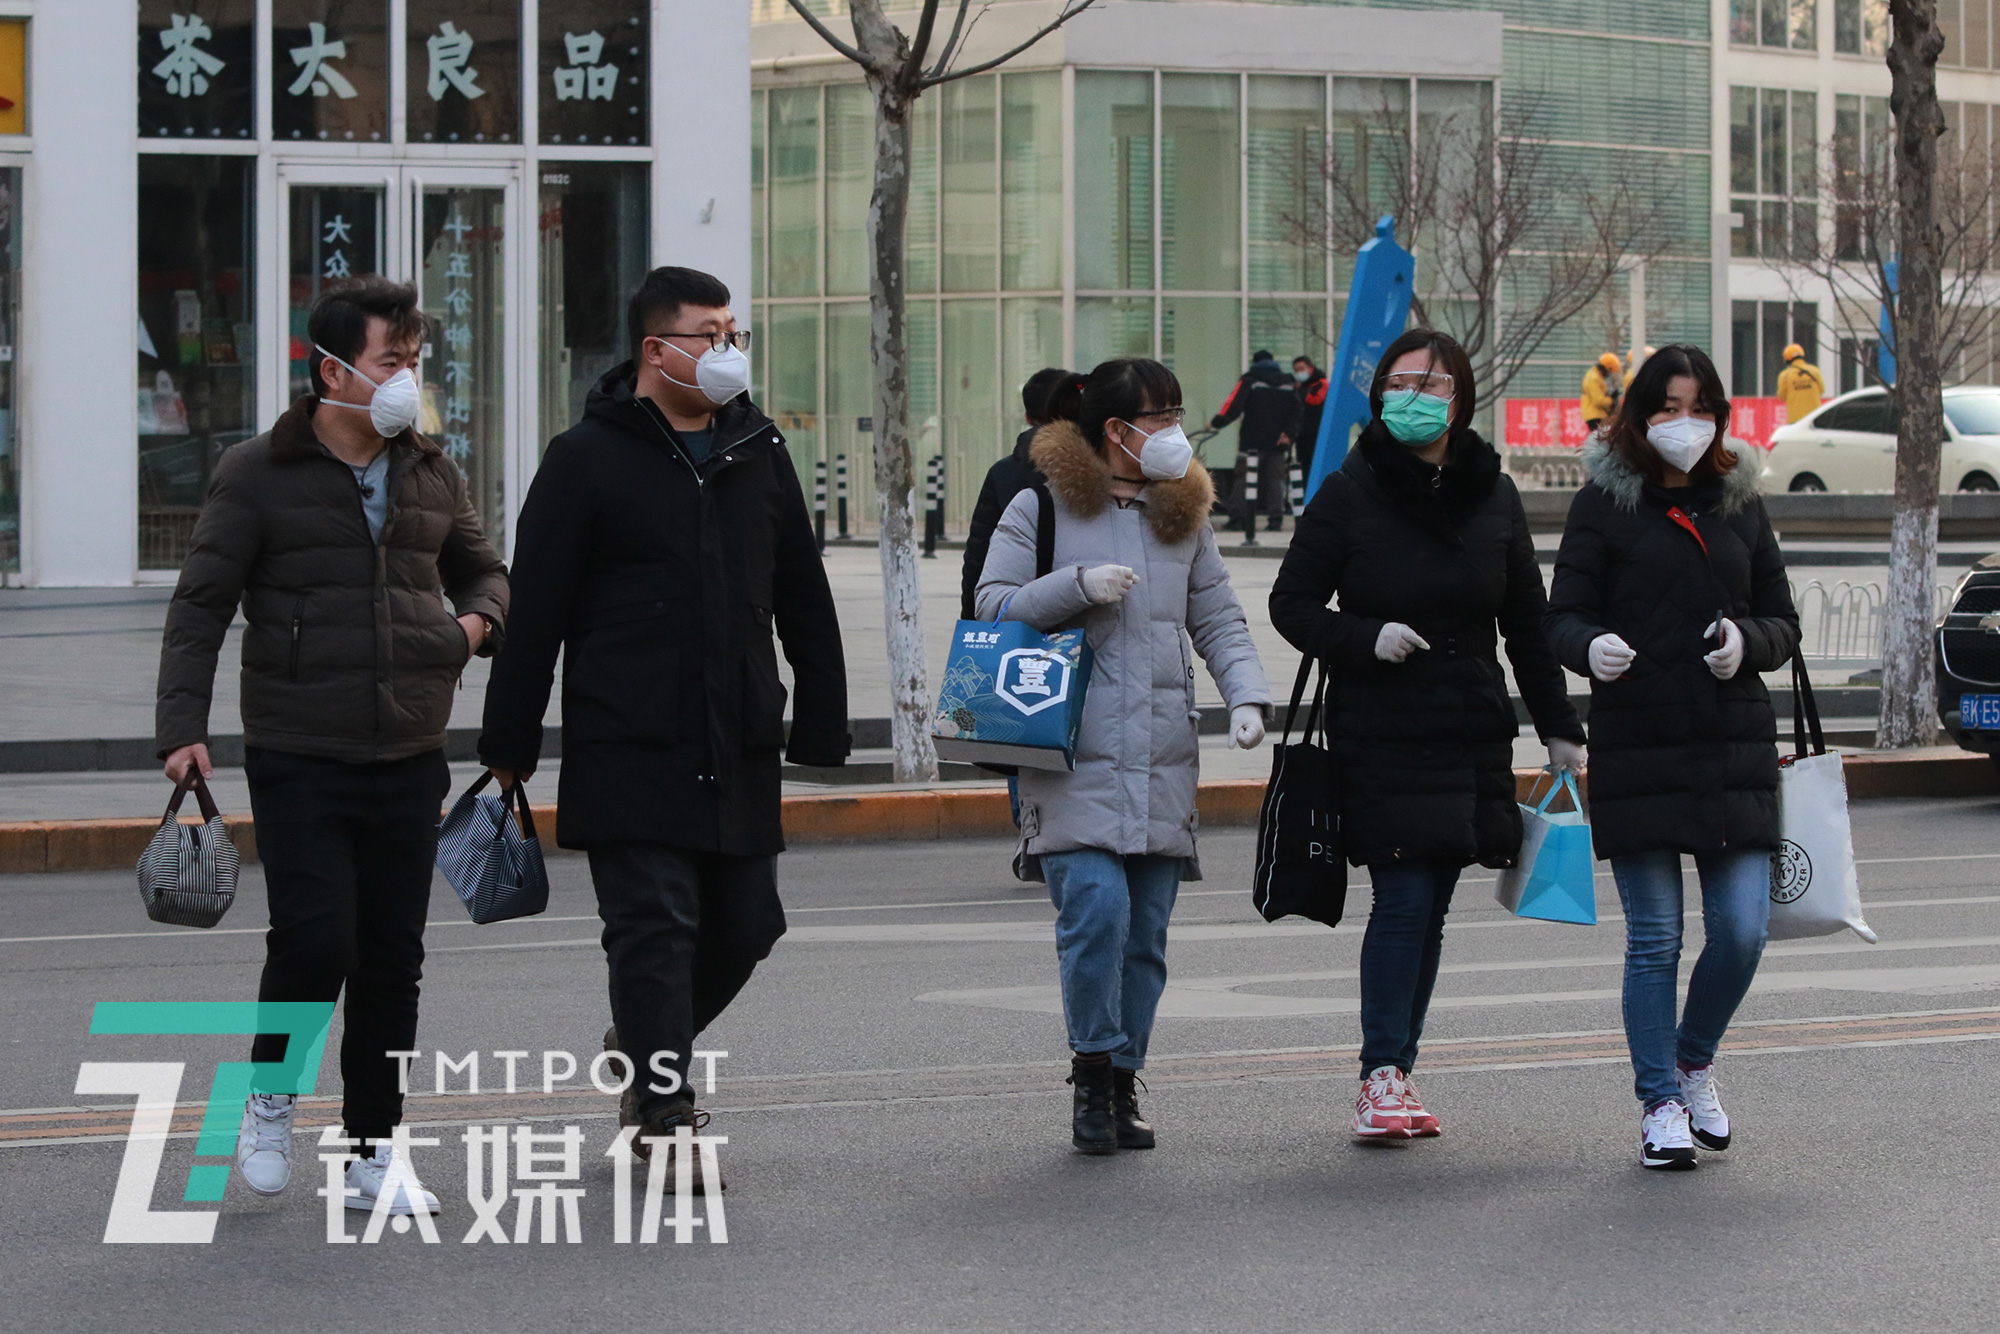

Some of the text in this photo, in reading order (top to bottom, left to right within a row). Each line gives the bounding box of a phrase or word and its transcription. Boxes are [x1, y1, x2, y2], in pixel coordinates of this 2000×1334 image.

[152, 12, 619, 101] 茶太良品
[1781, 868, 1808, 900] BETTER
